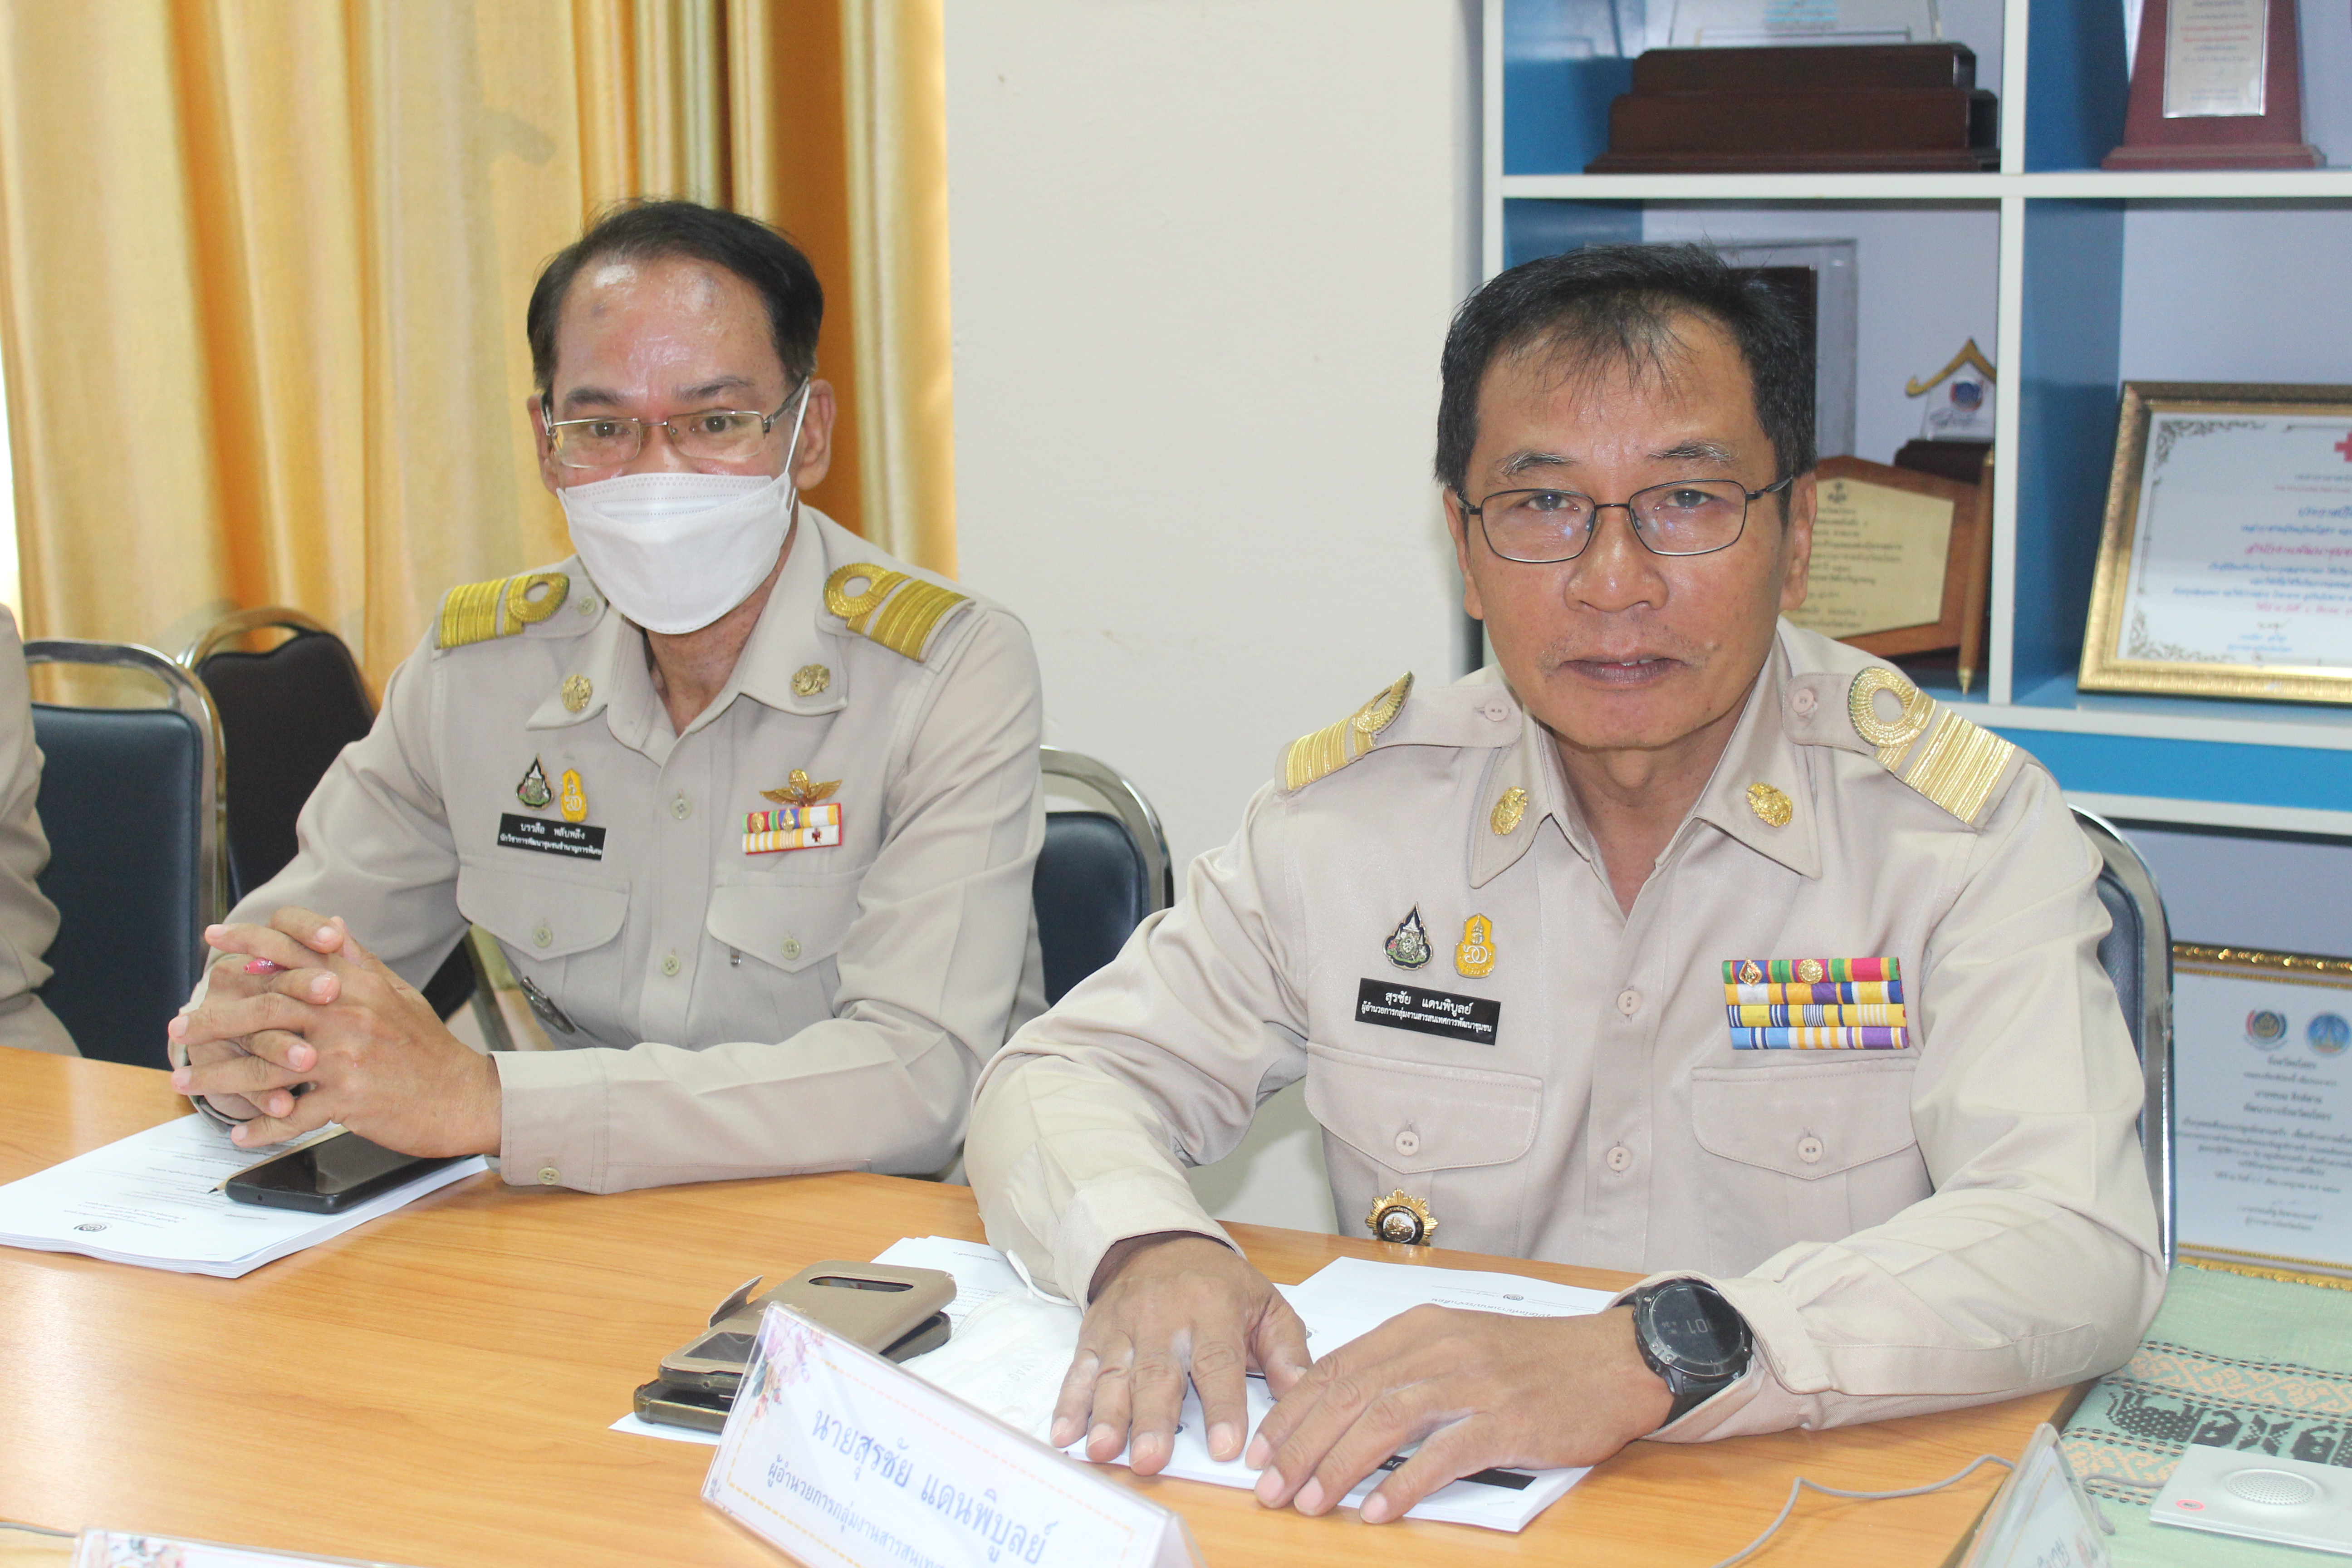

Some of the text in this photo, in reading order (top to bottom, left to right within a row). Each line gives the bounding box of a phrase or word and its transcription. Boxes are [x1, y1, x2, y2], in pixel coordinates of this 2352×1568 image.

[1361, 1000, 1492, 1033] ผู้อำนวยการกลุ่มงานสารสนเทศการพัฒนาชุมชน
[1384, 990, 1474, 1017] สุรชัย แดนพิบูลย์
[812, 1410, 1059, 1565] นายสุรชัย แดนพิบูลย์
